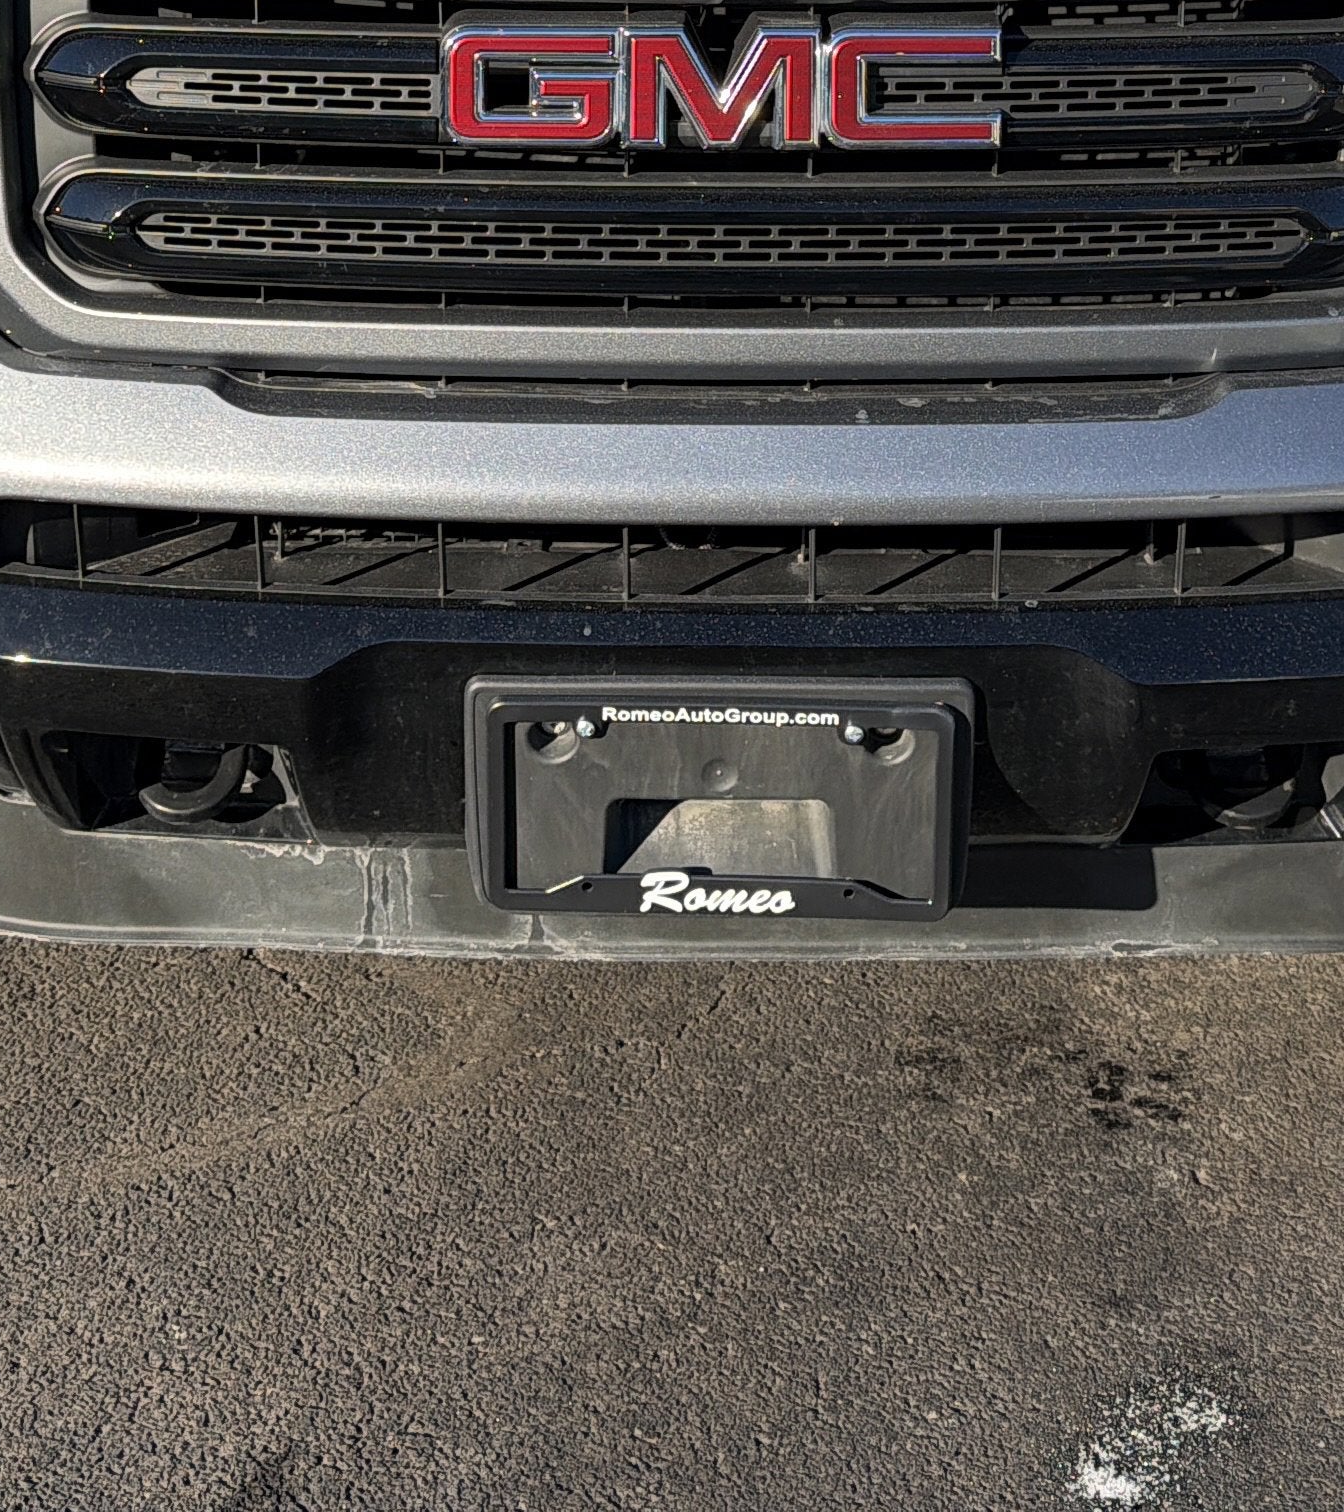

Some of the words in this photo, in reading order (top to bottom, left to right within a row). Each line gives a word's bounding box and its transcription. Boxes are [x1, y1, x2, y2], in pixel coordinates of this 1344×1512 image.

[442, 24, 1003, 150] GMC
[601, 706, 840, 728] RomeoAutoGroup.com
[639, 871, 796, 914] Romeo
